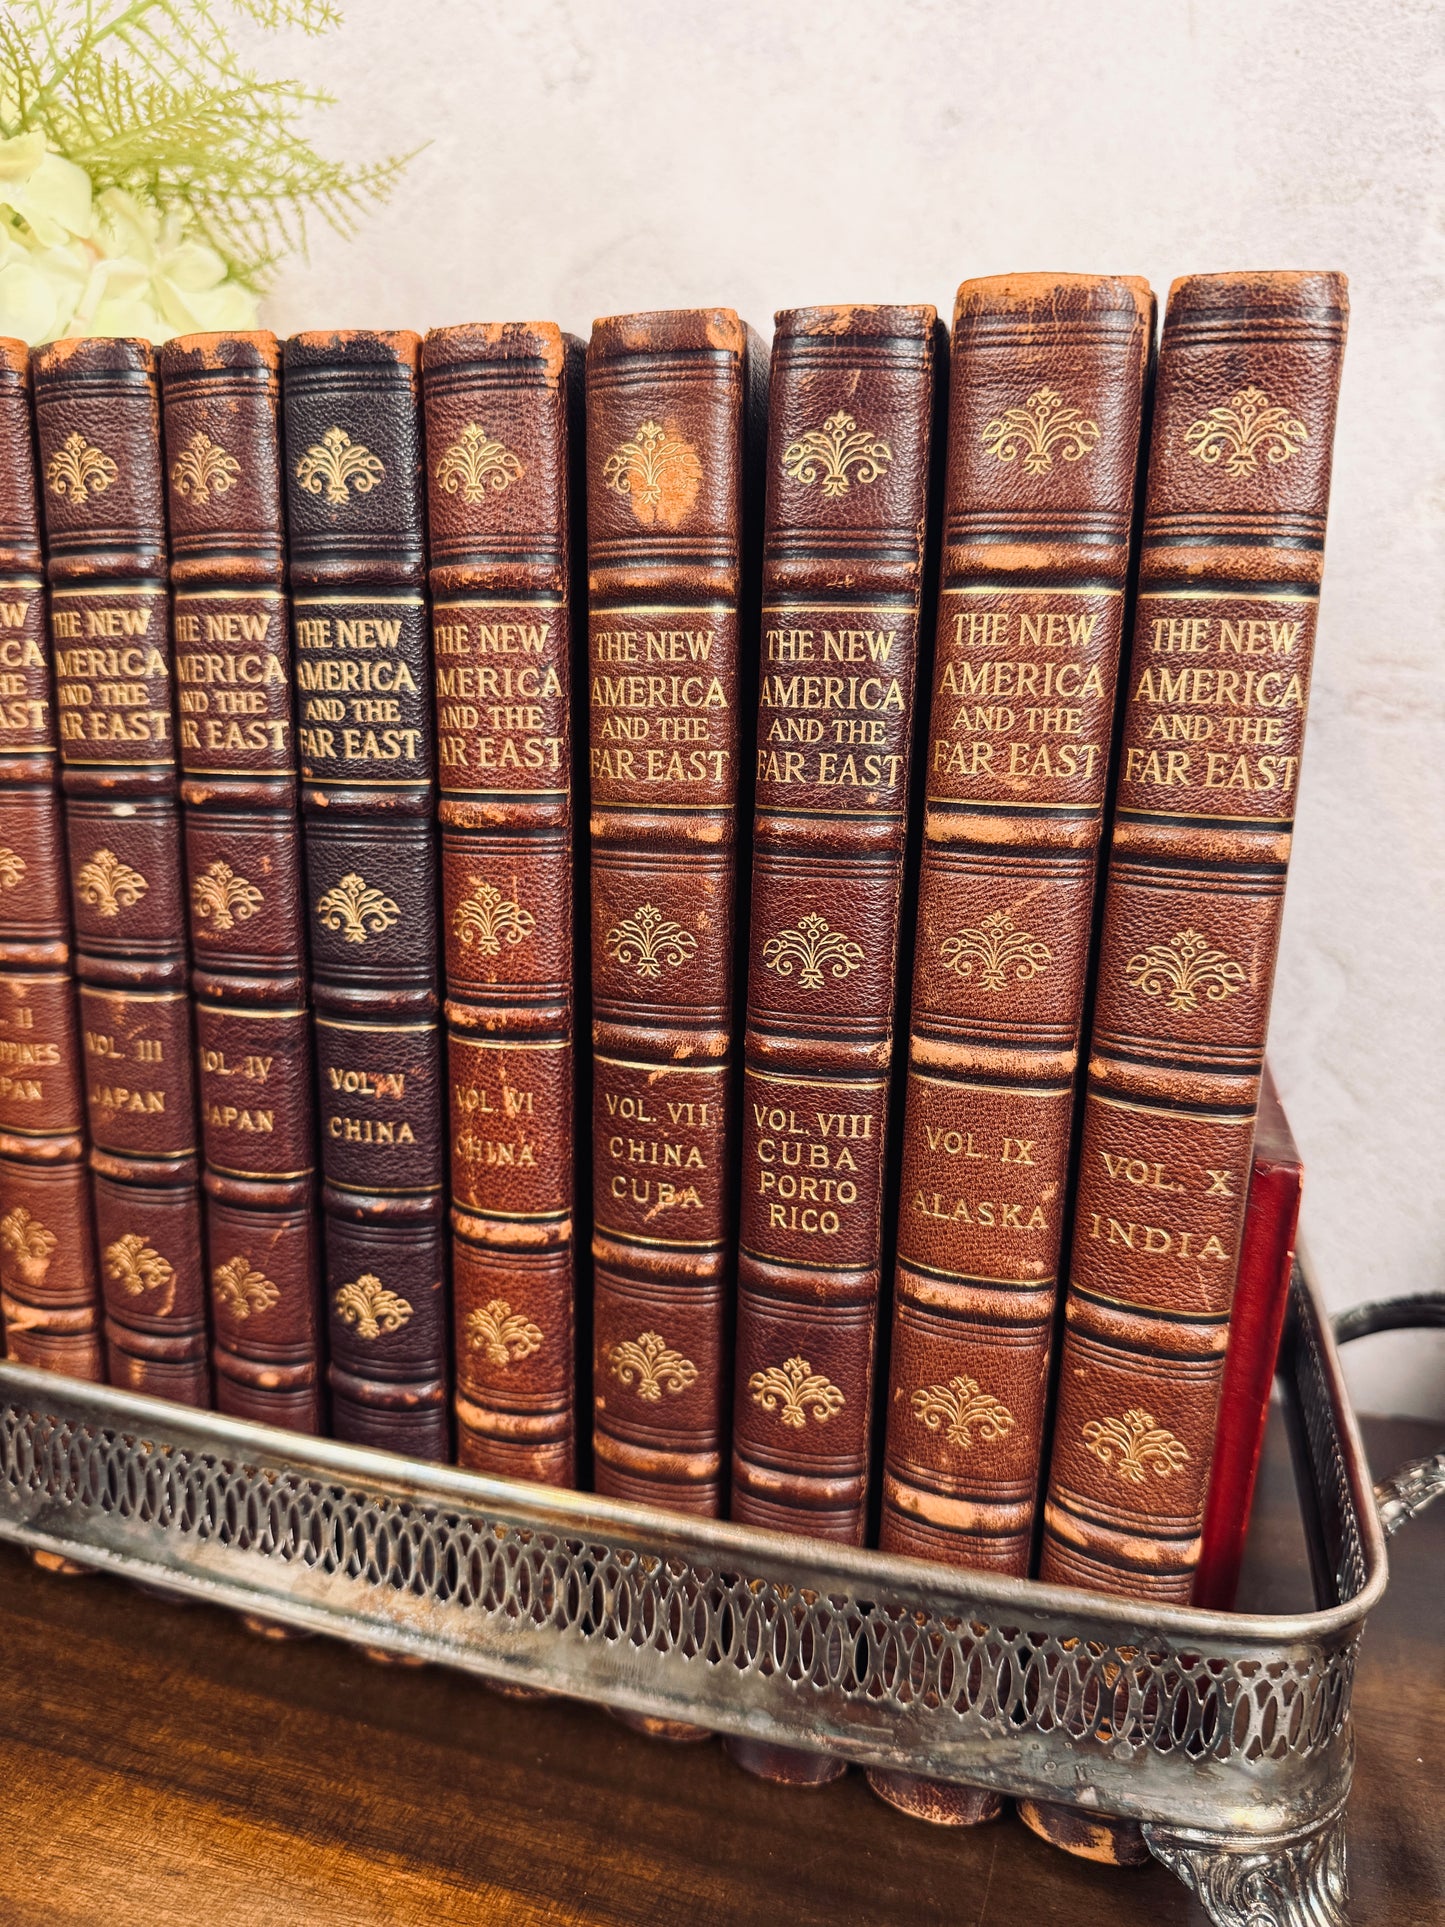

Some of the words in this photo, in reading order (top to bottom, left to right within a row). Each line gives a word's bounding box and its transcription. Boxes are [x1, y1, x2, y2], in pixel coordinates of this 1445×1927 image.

[86, 608, 152, 637] NEW
[206, 613, 270, 642] NEW
[296, 618, 333, 649] THE
[336, 619, 402, 649] NEW
[952, 613, 1011, 647] THE
[1018, 613, 1097, 647] NEW
[1152, 617, 1211, 653] THE
[1218, 620, 1300, 654] NEW
[434, 624, 470, 654] THE
[479, 624, 550, 653] NEW
[596, 631, 640, 662] THE
[645, 631, 714, 662] NEW
[766, 629, 815, 661] THE
[823, 630, 895, 662] NEW
[176, 653, 288, 683] MERICA
[436, 666, 565, 698] MERICA
[939, 662, 1105, 698] AMERICA
[98, 681, 150, 705] THE
[214, 690, 268, 713] THE
[591, 676, 728, 708] AMERICA
[760, 675, 905, 711] AMERICA
[1133, 668, 1304, 708] AMERICA
[91, 711, 171, 740] EAST
[305, 698, 346, 722] AND
[352, 699, 401, 722] THE
[440, 705, 479, 729] AND
[487, 706, 545, 730] THE
[952, 707, 1014, 732] AND
[1023, 708, 1084, 734] THE
[207, 719, 289, 750] EAST
[299, 727, 337, 758] FAR
[343, 728, 420, 759] EAST
[600, 716, 649, 740] AND
[657, 717, 710, 742] THE
[768, 718, 823, 743] AND
[832, 719, 887, 745] THE
[1146, 714, 1214, 742] AND
[1222, 716, 1283, 746] THE
[438, 735, 469, 766] AR
[478, 737, 564, 767] EAST
[590, 748, 637, 780] FAR
[648, 750, 730, 781] EAST
[934, 739, 996, 775] FAR
[1009, 742, 1101, 779] EAST
[757, 750, 806, 784] FAR
[818, 753, 903, 787] EAST
[1123, 748, 1191, 786] FAR
[1204, 752, 1299, 791] EAST
[134, 1039, 164, 1062] III
[244, 1056, 273, 1081] IV
[89, 1085, 166, 1113] JAPAN
[508, 1092, 533, 1114] VI
[605, 1093, 657, 1122] VOL.
[666, 1102, 709, 1126] VII
[329, 1117, 417, 1144] CHINA
[753, 1103, 811, 1136] VOL.
[816, 1112, 873, 1138] VIII
[455, 1135, 537, 1167] CHINA
[609, 1136, 707, 1168] CHINA
[757, 1139, 858, 1170] CUBA
[925, 1125, 989, 1159] VOL.
[1000, 1137, 1035, 1165] IX
[758, 1170, 857, 1204] PORTO
[1100, 1151, 1185, 1194] VOL.
[1206, 1170, 1234, 1195] X
[611, 1176, 704, 1208] CUBA
[769, 1203, 840, 1234] RICO
[911, 1190, 1049, 1229] ALASKA
[1091, 1213, 1230, 1260] INDIA
